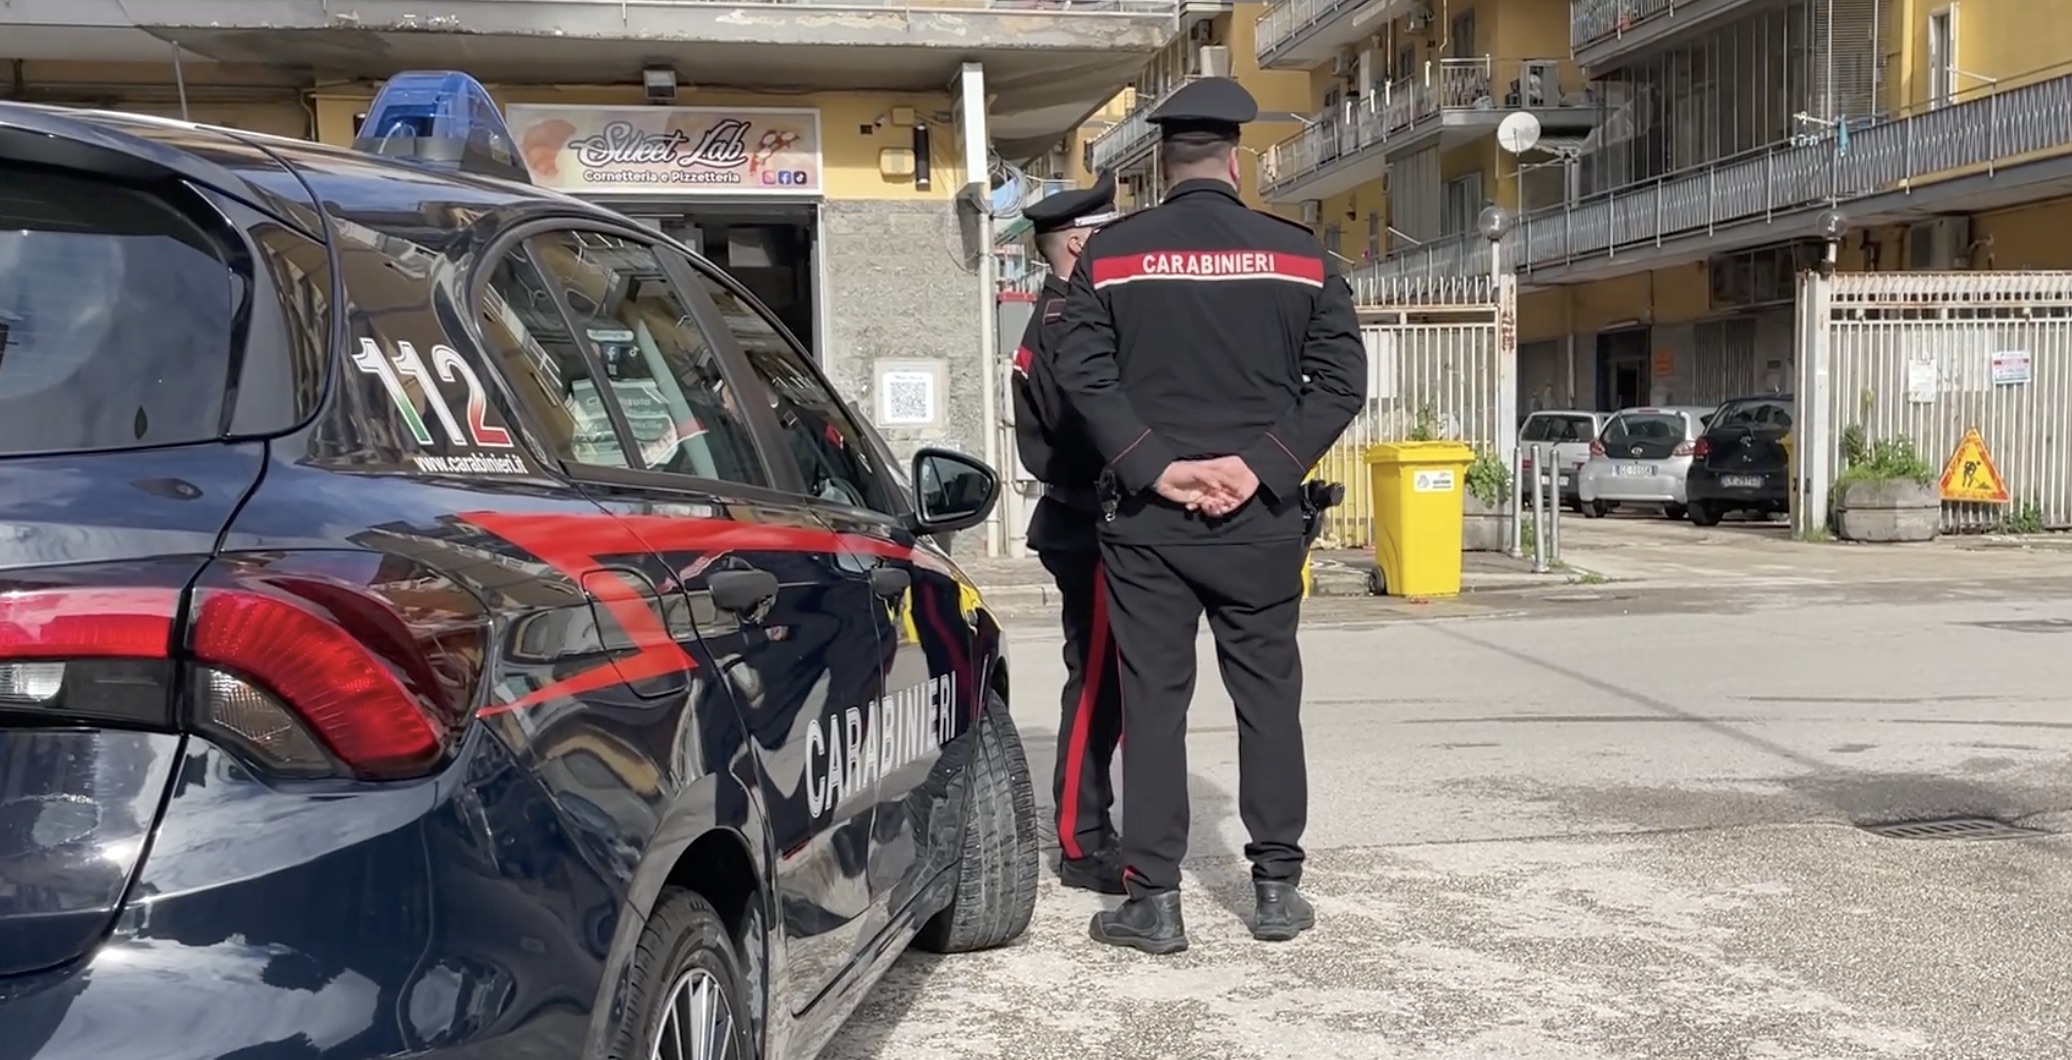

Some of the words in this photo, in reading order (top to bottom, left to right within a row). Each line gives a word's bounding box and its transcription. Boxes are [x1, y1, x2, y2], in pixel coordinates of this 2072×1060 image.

[568, 121, 689, 168] Sweet
[677, 119, 751, 168] Lab
[583, 170, 658, 183] Cornetteria
[660, 173, 669, 183] e
[671, 170, 741, 184] Pizzetteria
[1142, 252, 1275, 275] CARABINIERI
[352, 337, 514, 448] 112
[413, 452, 529, 474] www.carabinieri.it
[805, 670, 957, 819] CARABINIERI
